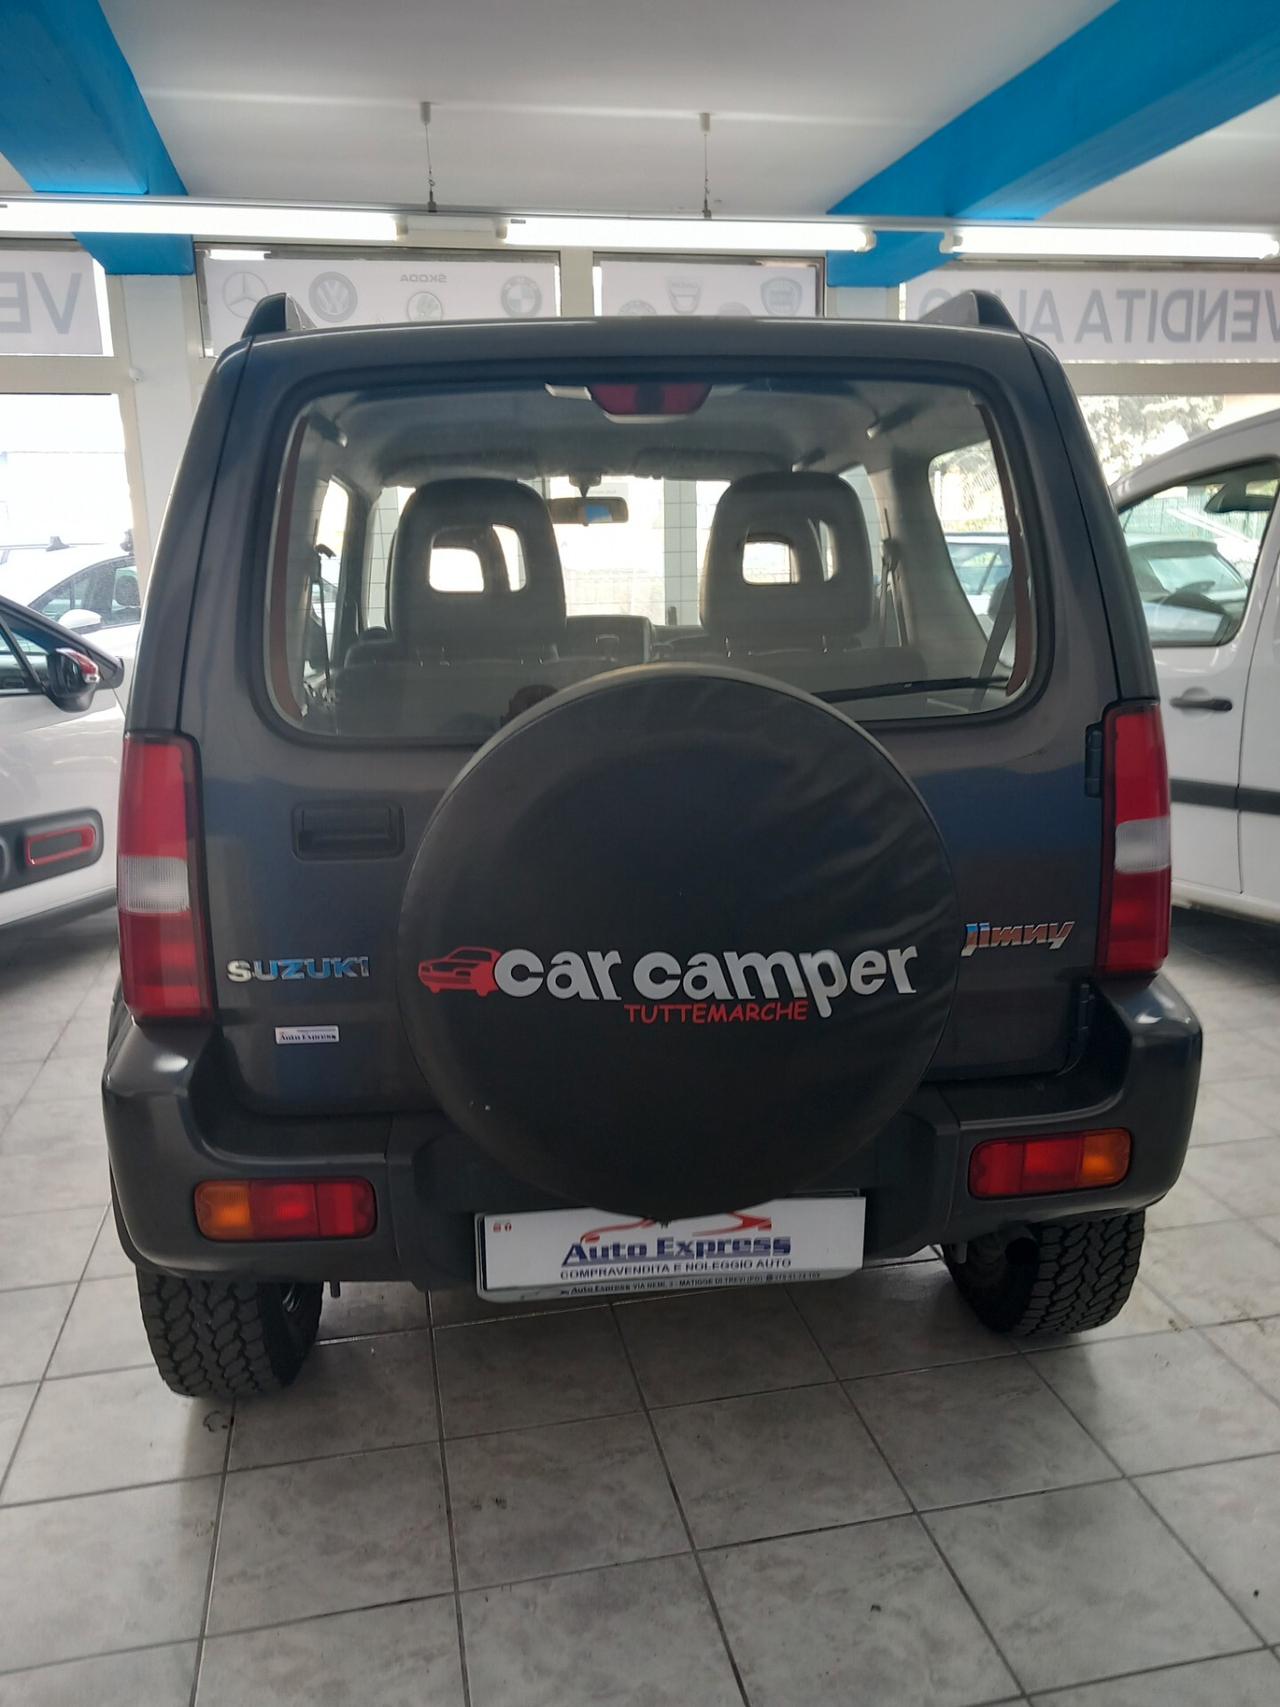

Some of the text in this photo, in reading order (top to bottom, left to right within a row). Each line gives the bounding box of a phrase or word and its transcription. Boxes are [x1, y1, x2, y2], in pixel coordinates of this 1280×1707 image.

[226, 956, 371, 983] SUZUKI
[494, 945, 918, 1019] car camper
[624, 1001, 809, 1024] TUTTEMARCHE
[561, 1235, 791, 1267] Auto Express
[560, 1257, 792, 1280] COMPRAVENDITA E NOLEGGIO AUTO
